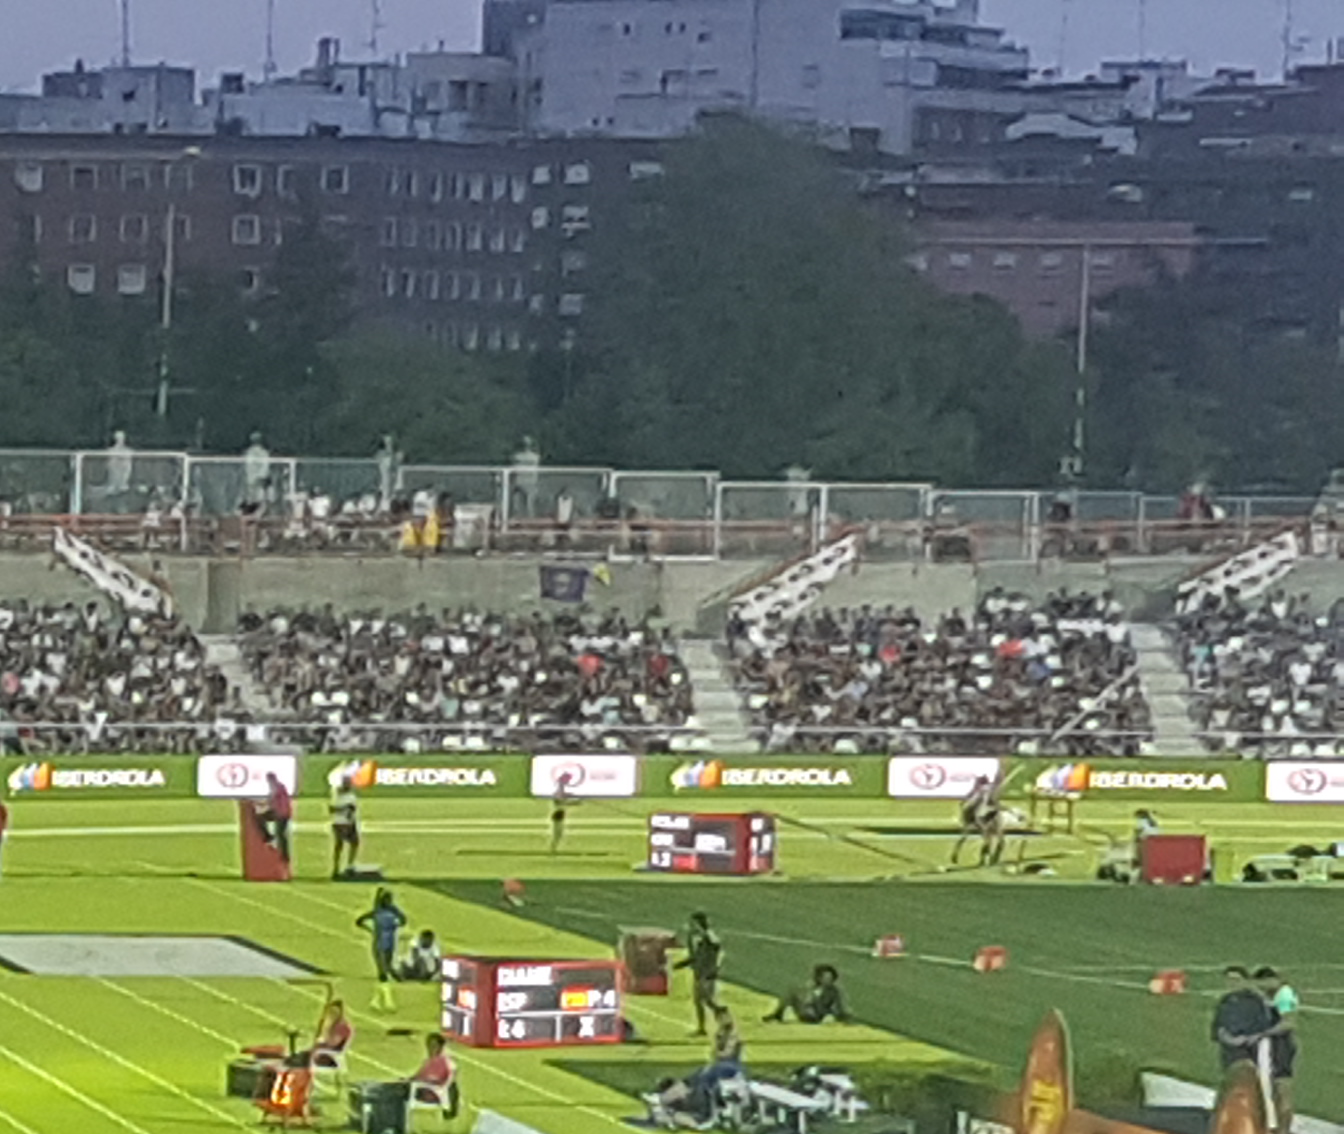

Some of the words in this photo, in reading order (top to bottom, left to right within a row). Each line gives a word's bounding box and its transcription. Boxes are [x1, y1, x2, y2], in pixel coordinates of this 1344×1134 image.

[375, 768, 496, 786] IBERDROLA
[721, 768, 852, 786] IBERDROLA
[1089, 772, 1228, 791] IBERDROLA
